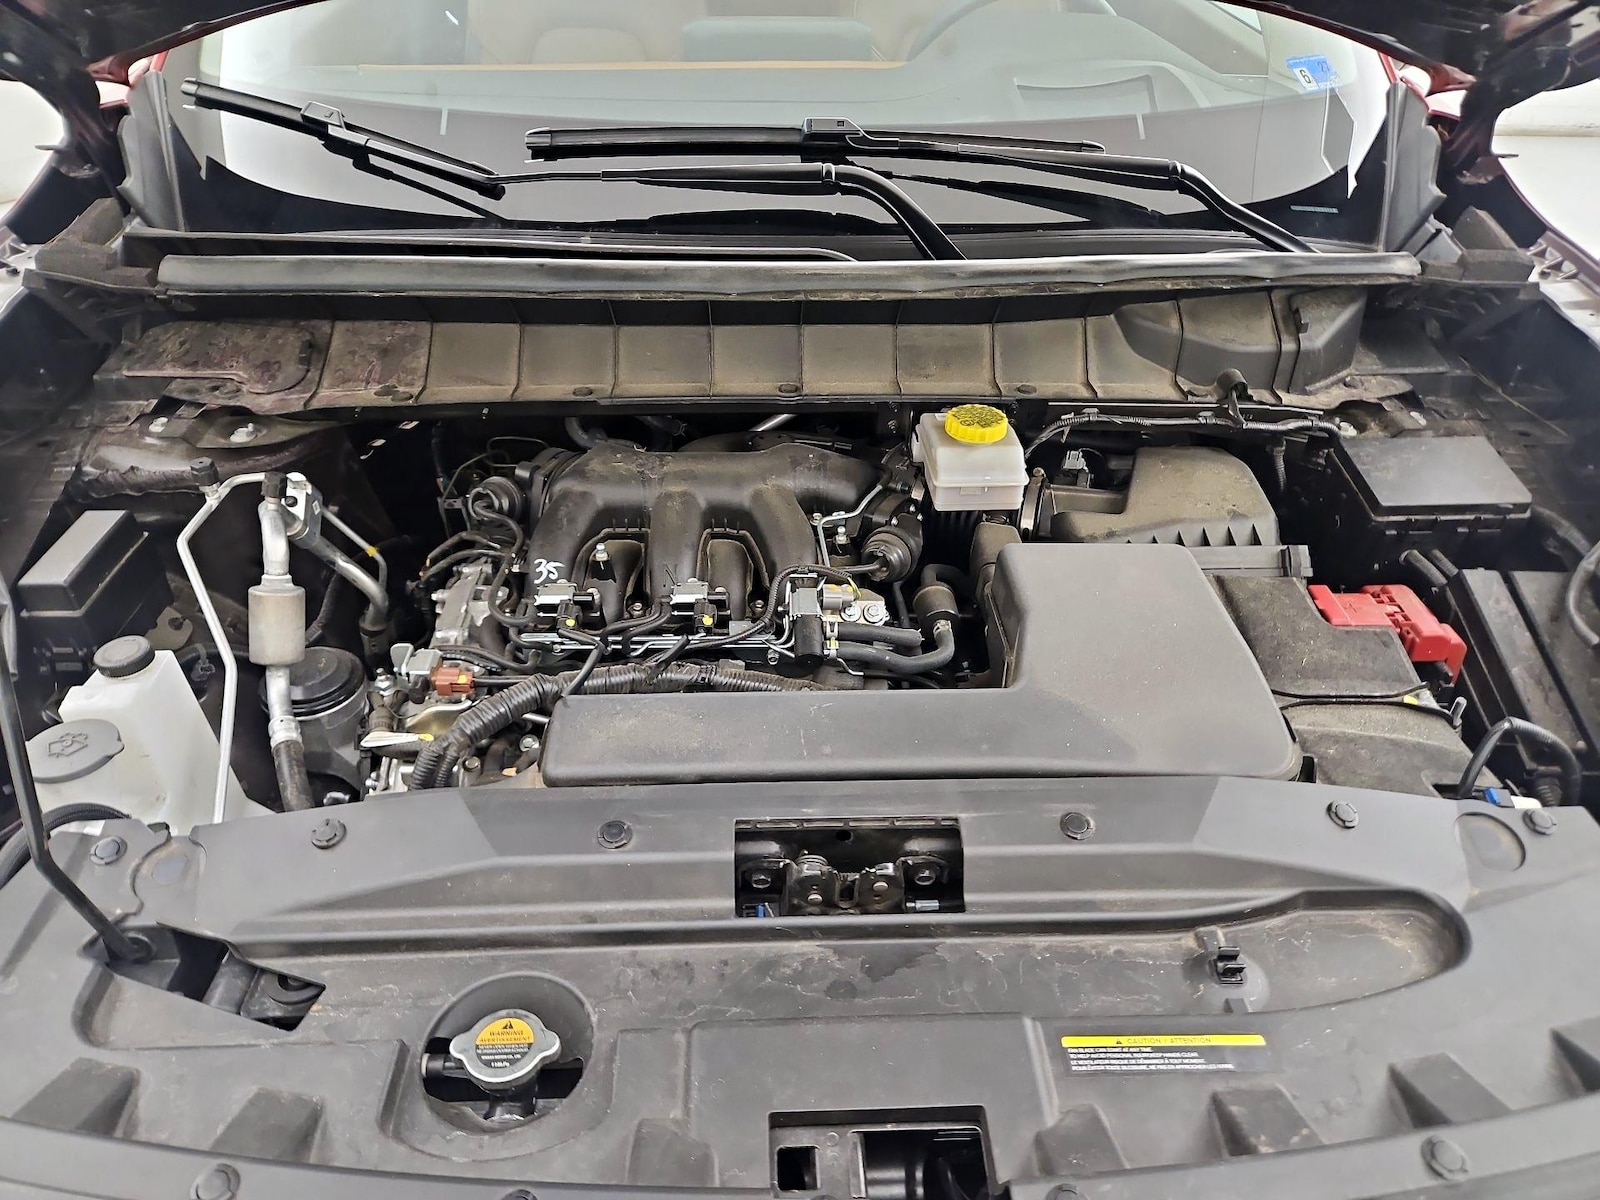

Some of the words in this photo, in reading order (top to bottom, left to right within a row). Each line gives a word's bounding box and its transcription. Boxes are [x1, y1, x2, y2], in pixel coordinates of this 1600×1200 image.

[1299, 68, 1312, 84] 6
[533, 558, 566, 585] 35
[1126, 1037, 1162, 1045] CAUTION
